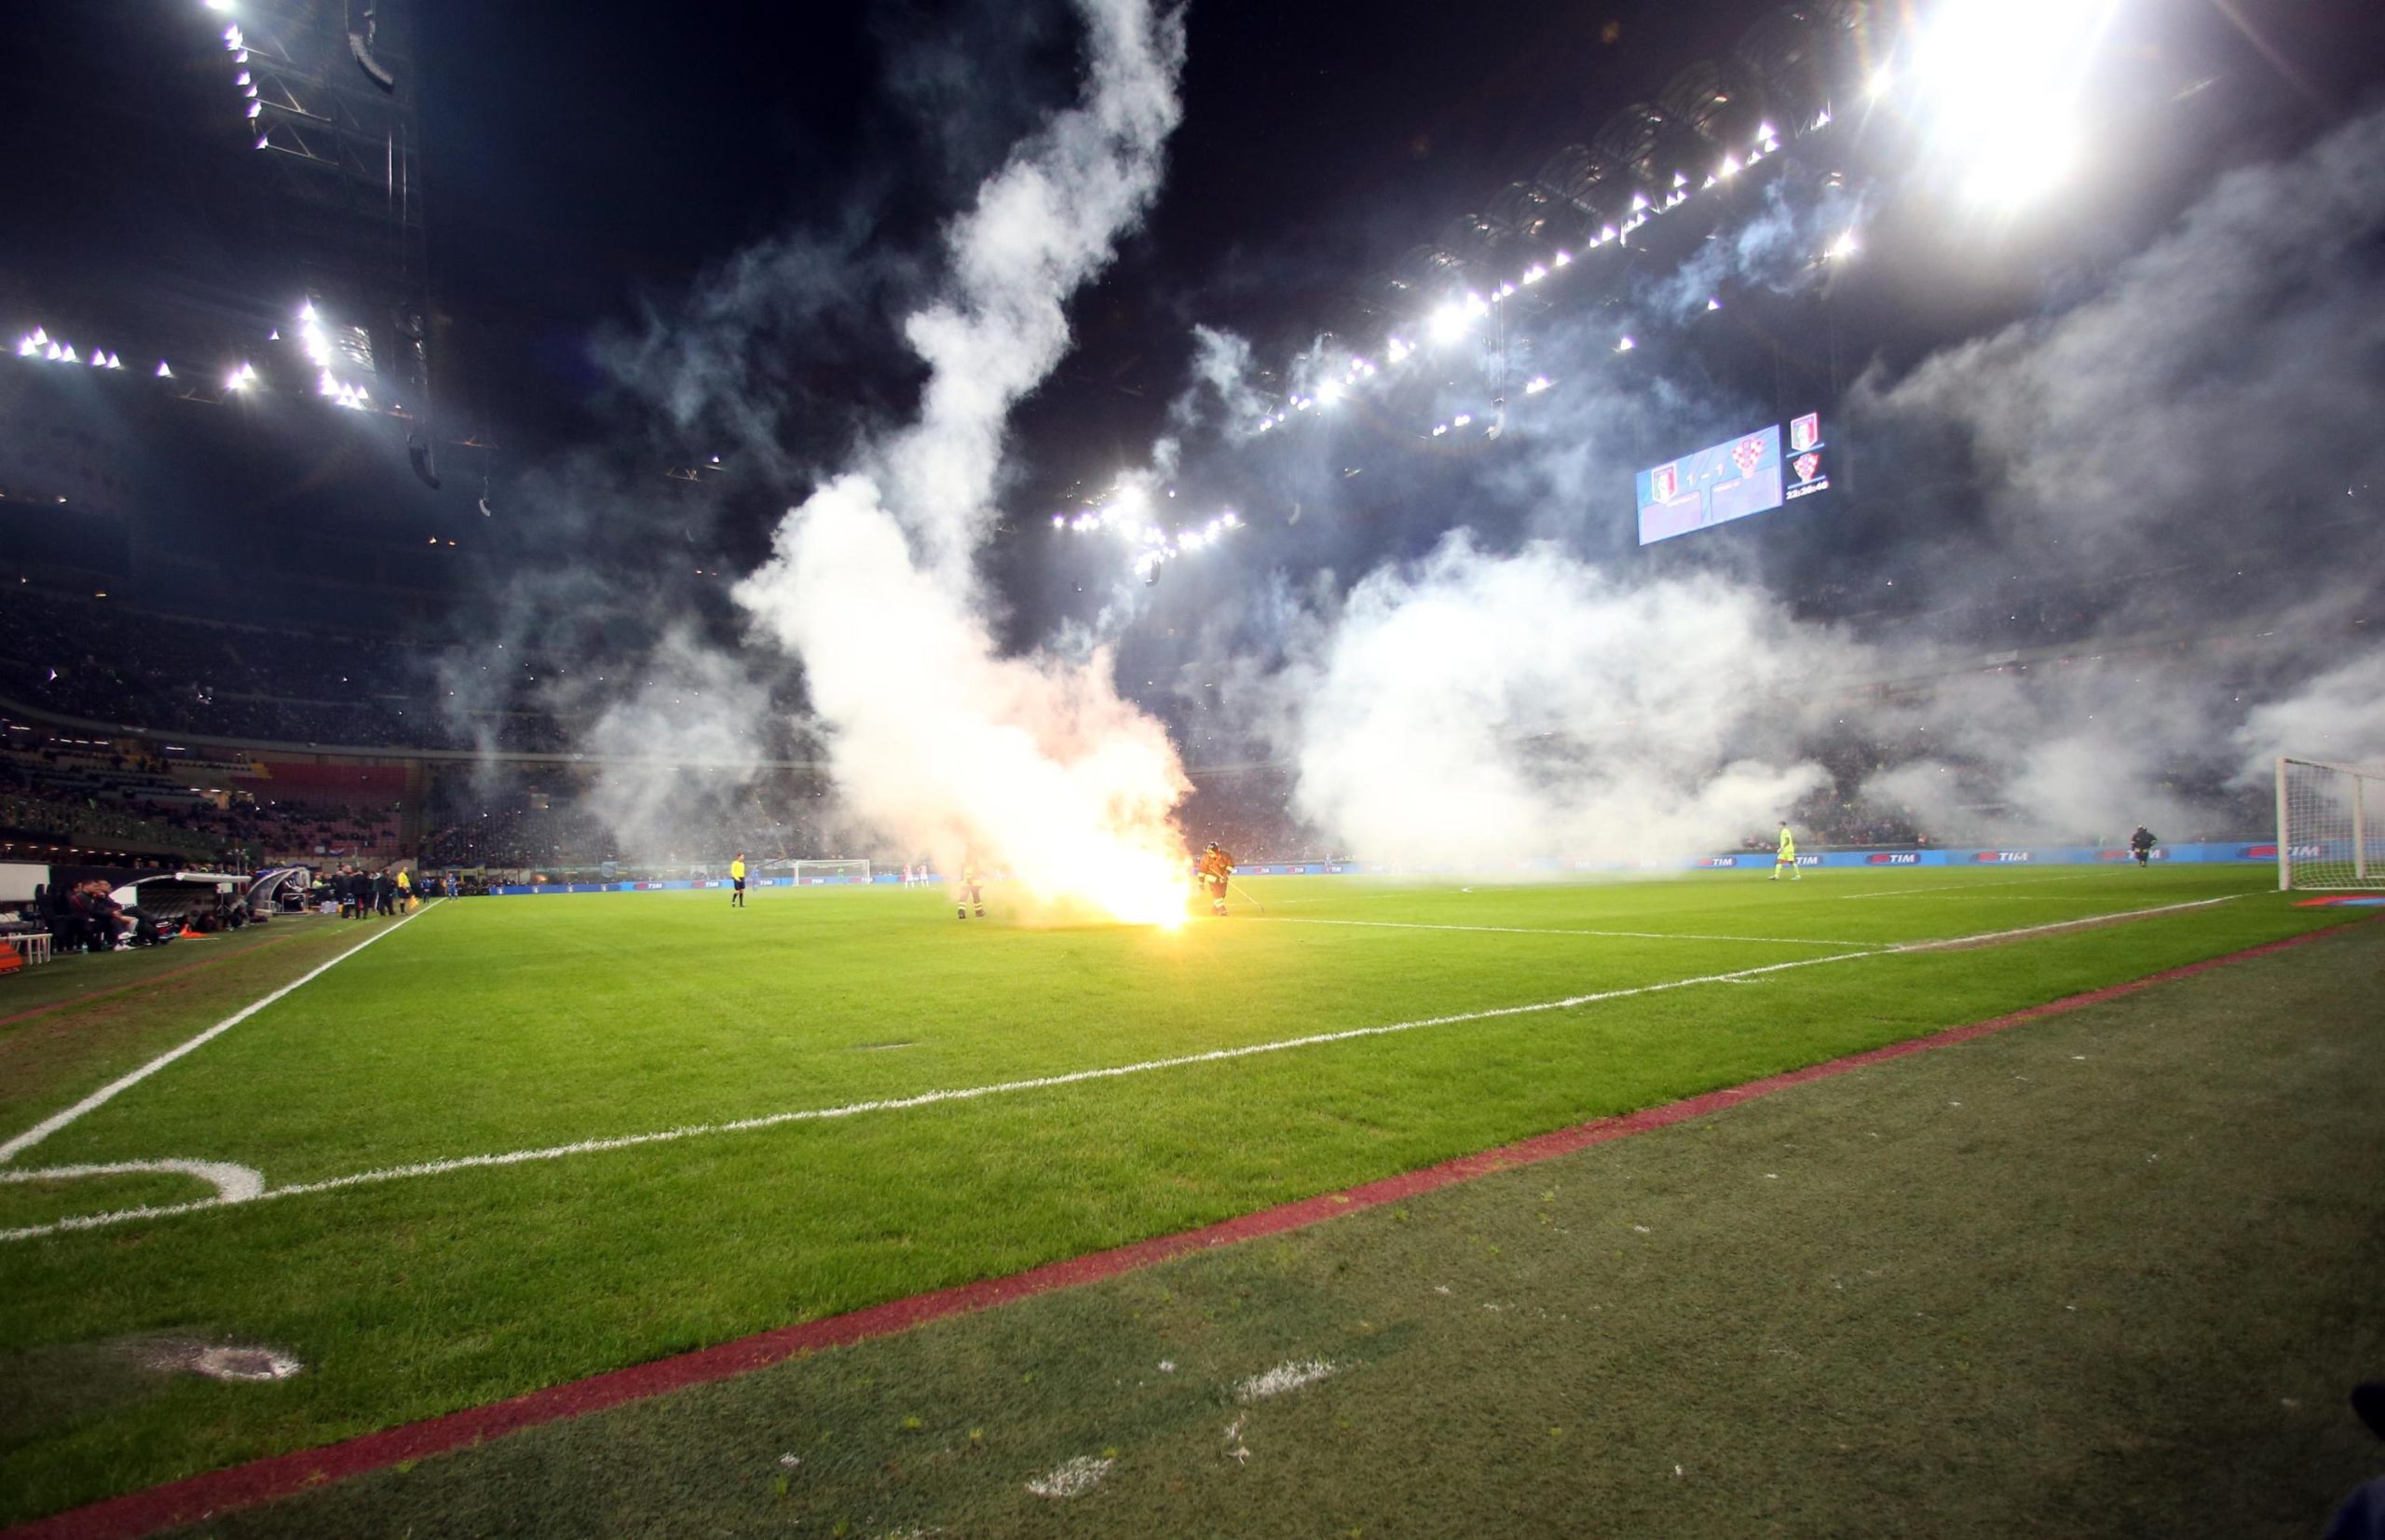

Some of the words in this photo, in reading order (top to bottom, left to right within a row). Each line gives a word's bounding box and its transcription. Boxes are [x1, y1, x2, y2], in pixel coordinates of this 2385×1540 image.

[1998, 852, 2027, 861] TIM
[2126, 849, 2161, 858] TM
[1796, 856, 1818, 865] TIM
[1889, 854, 1915, 863] TIM
